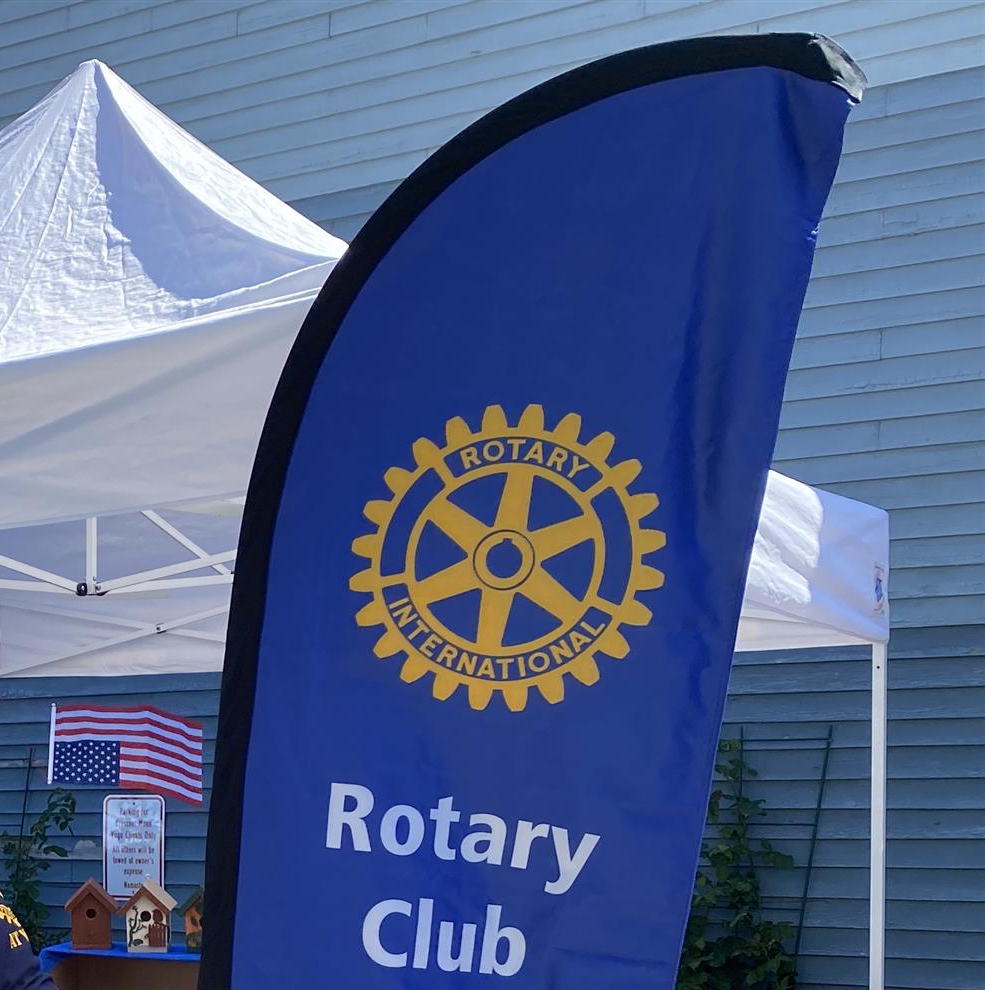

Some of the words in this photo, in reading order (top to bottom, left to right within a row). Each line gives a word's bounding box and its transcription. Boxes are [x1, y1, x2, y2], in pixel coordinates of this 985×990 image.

[460, 438, 590, 478] ROTARY
[388, 597, 606, 680] INTERNATIONAL
[121, 846, 136, 854] others
[138, 846, 147, 854] will
[148, 846, 155, 854] be
[326, 782, 601, 895] Rotary
[362, 897, 527, 977] Club
